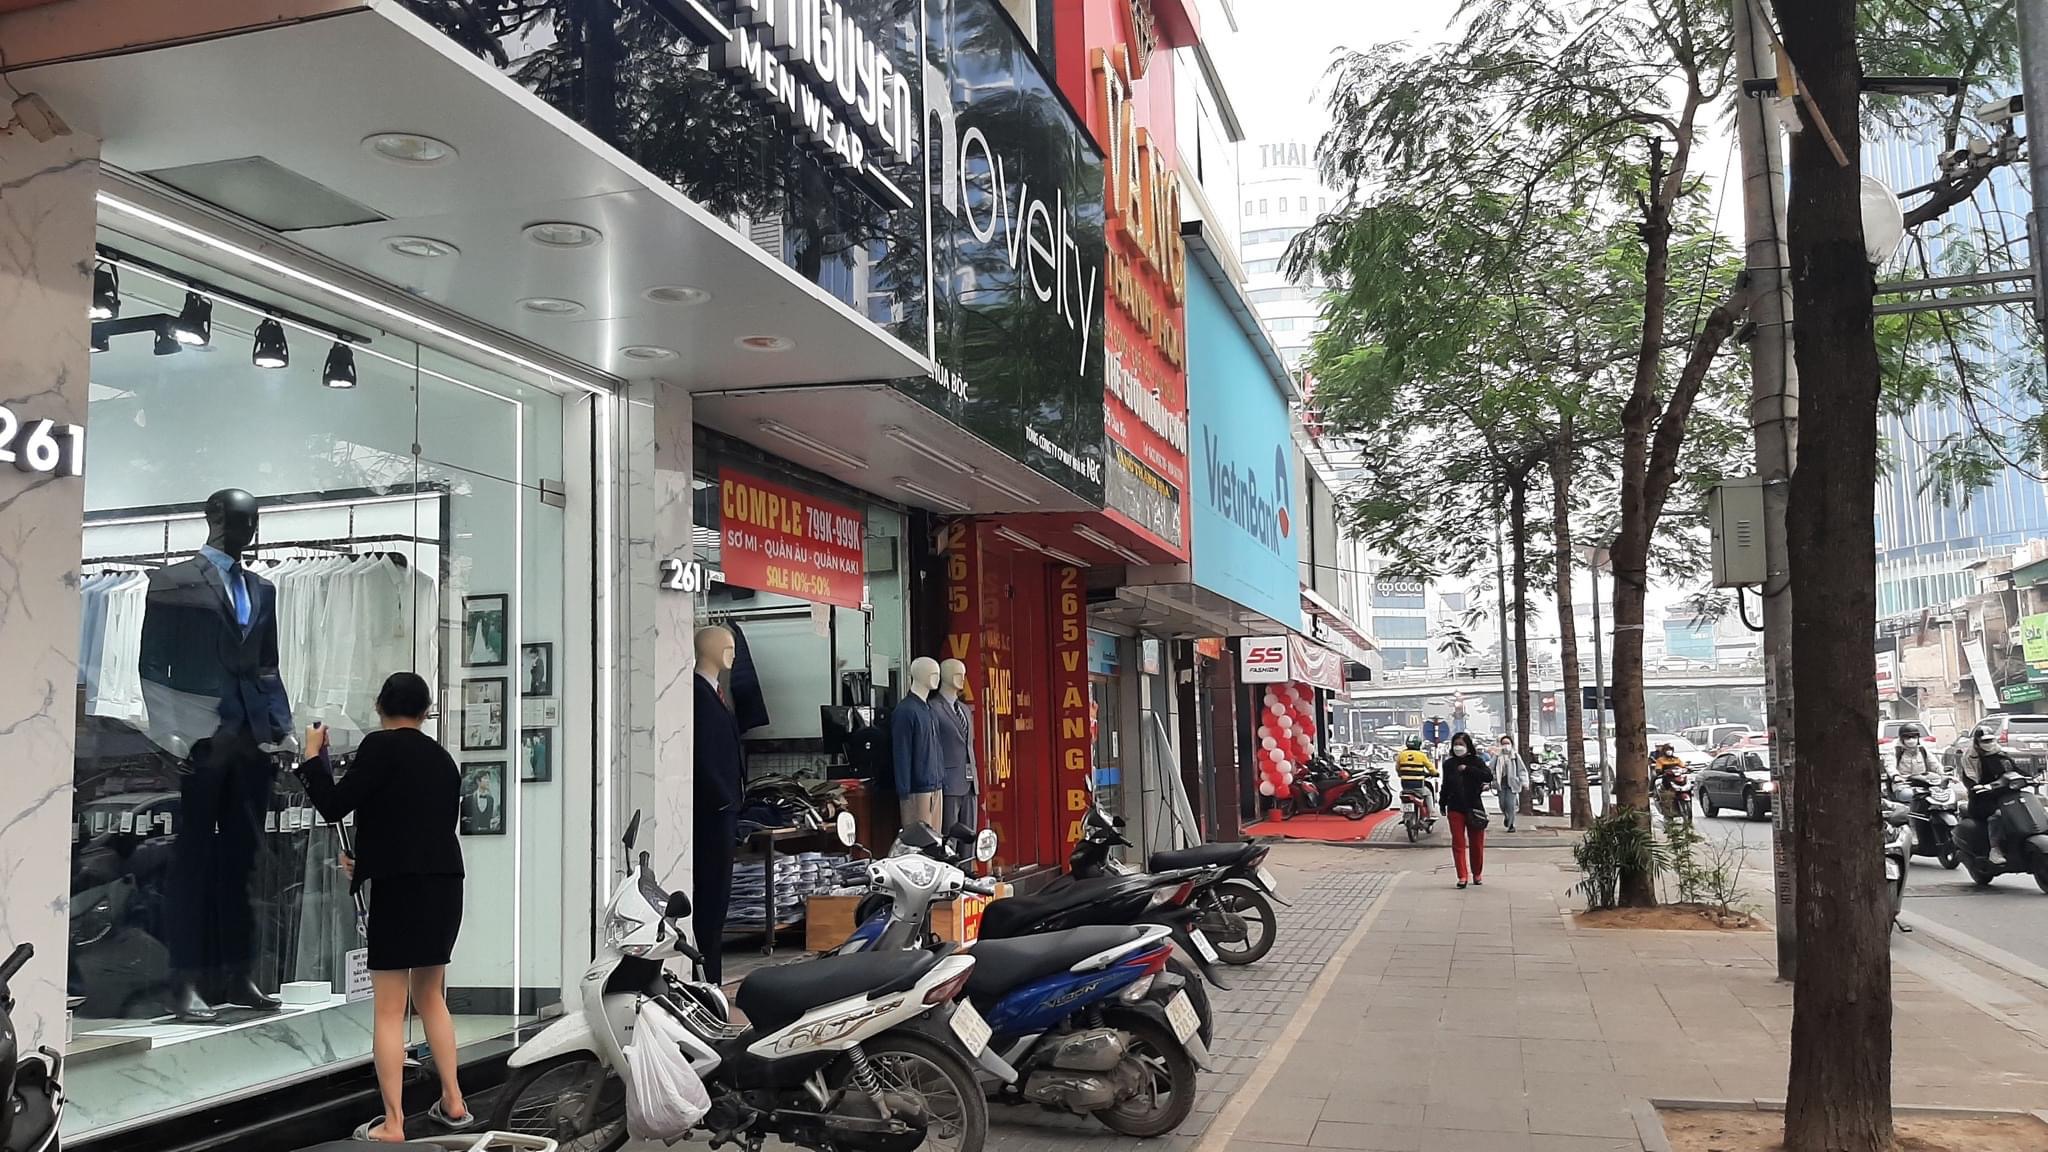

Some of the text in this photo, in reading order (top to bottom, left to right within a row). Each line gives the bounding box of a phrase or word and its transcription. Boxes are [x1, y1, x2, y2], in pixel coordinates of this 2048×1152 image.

[740, 26, 864, 175] MEN WEAR
[928, 62, 1098, 377] novelty
[928, 359, 950, 391] HÙA
[0, 405, 84, 477] 261
[723, 479, 861, 551] COMPLE 799K-999K
[1203, 423, 1280, 556] VietinBank
[671, 558, 701, 593] 261
[728, 529, 743, 547] SƠ
[745, 535, 758, 552] MI
[840, 556, 859, 576] KAKI
[766, 564, 788, 590] SALE
